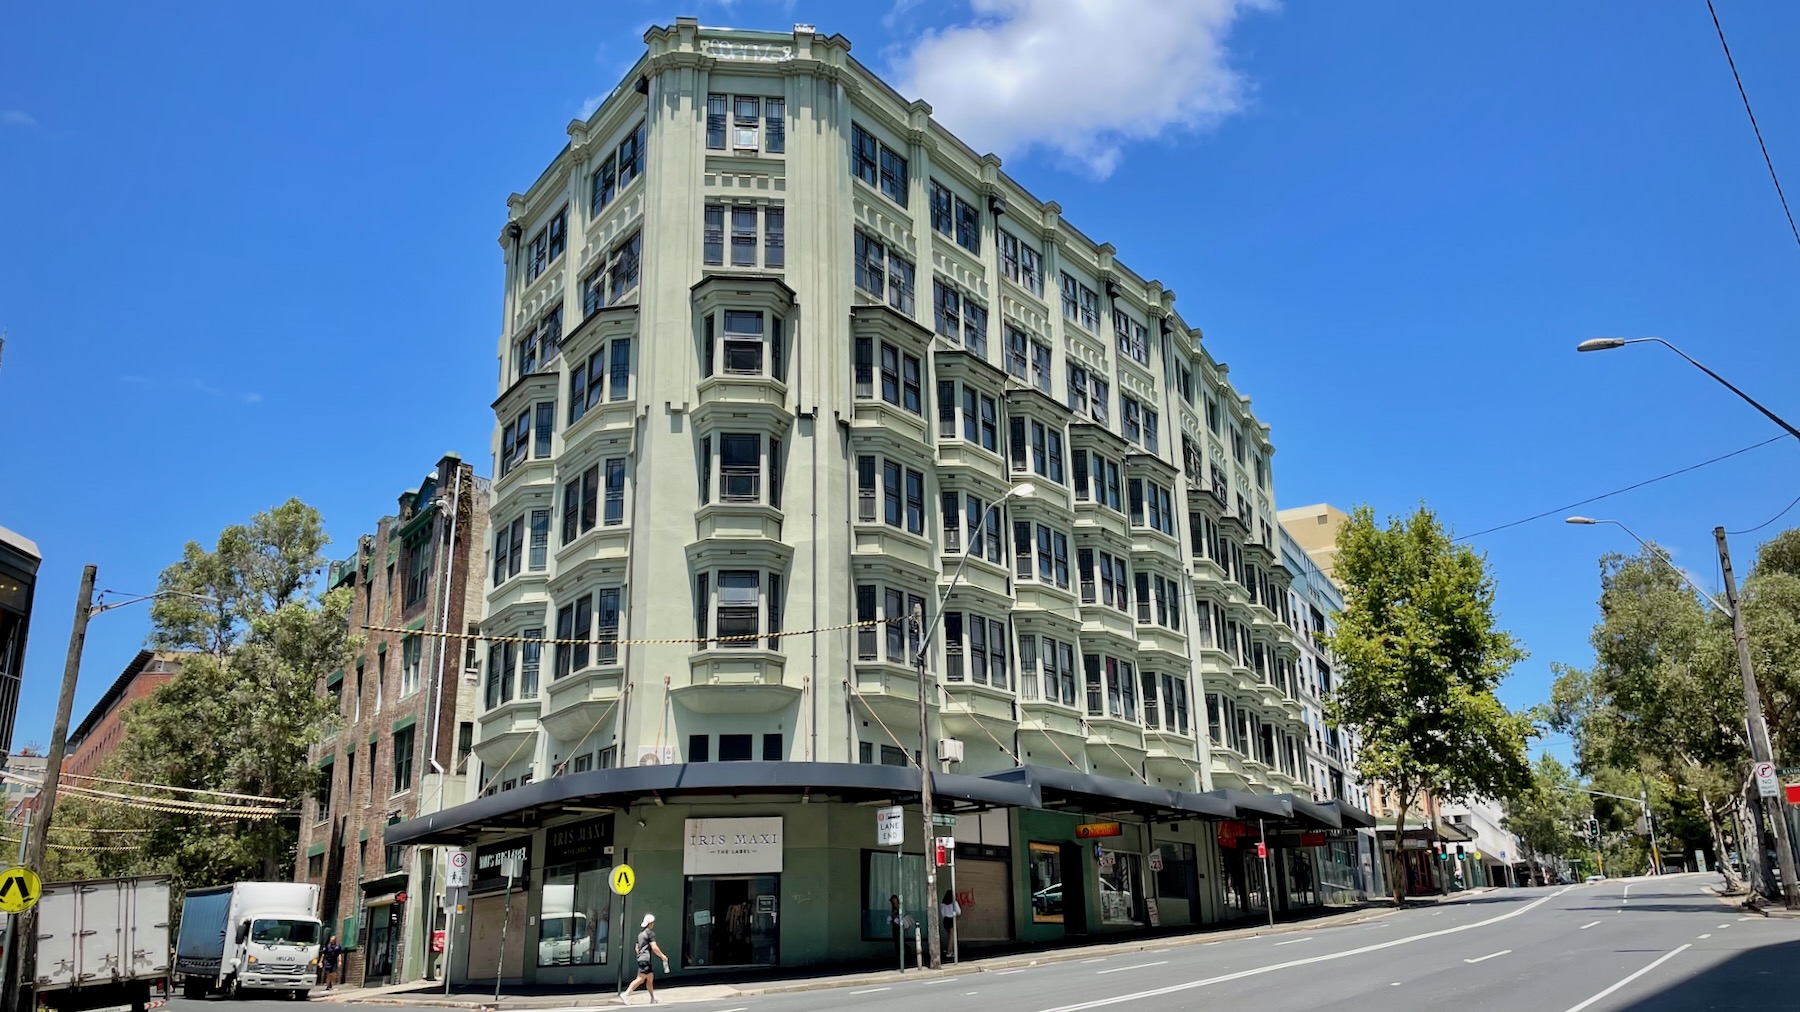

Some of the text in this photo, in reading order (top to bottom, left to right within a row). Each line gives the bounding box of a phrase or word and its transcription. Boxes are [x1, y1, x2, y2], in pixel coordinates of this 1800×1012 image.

[880, 822, 899, 831] LANE
[553, 822, 605, 847] IRIS MAXI
[883, 831, 898, 840] END
[690, 834, 777, 846] IRIS MAXI
